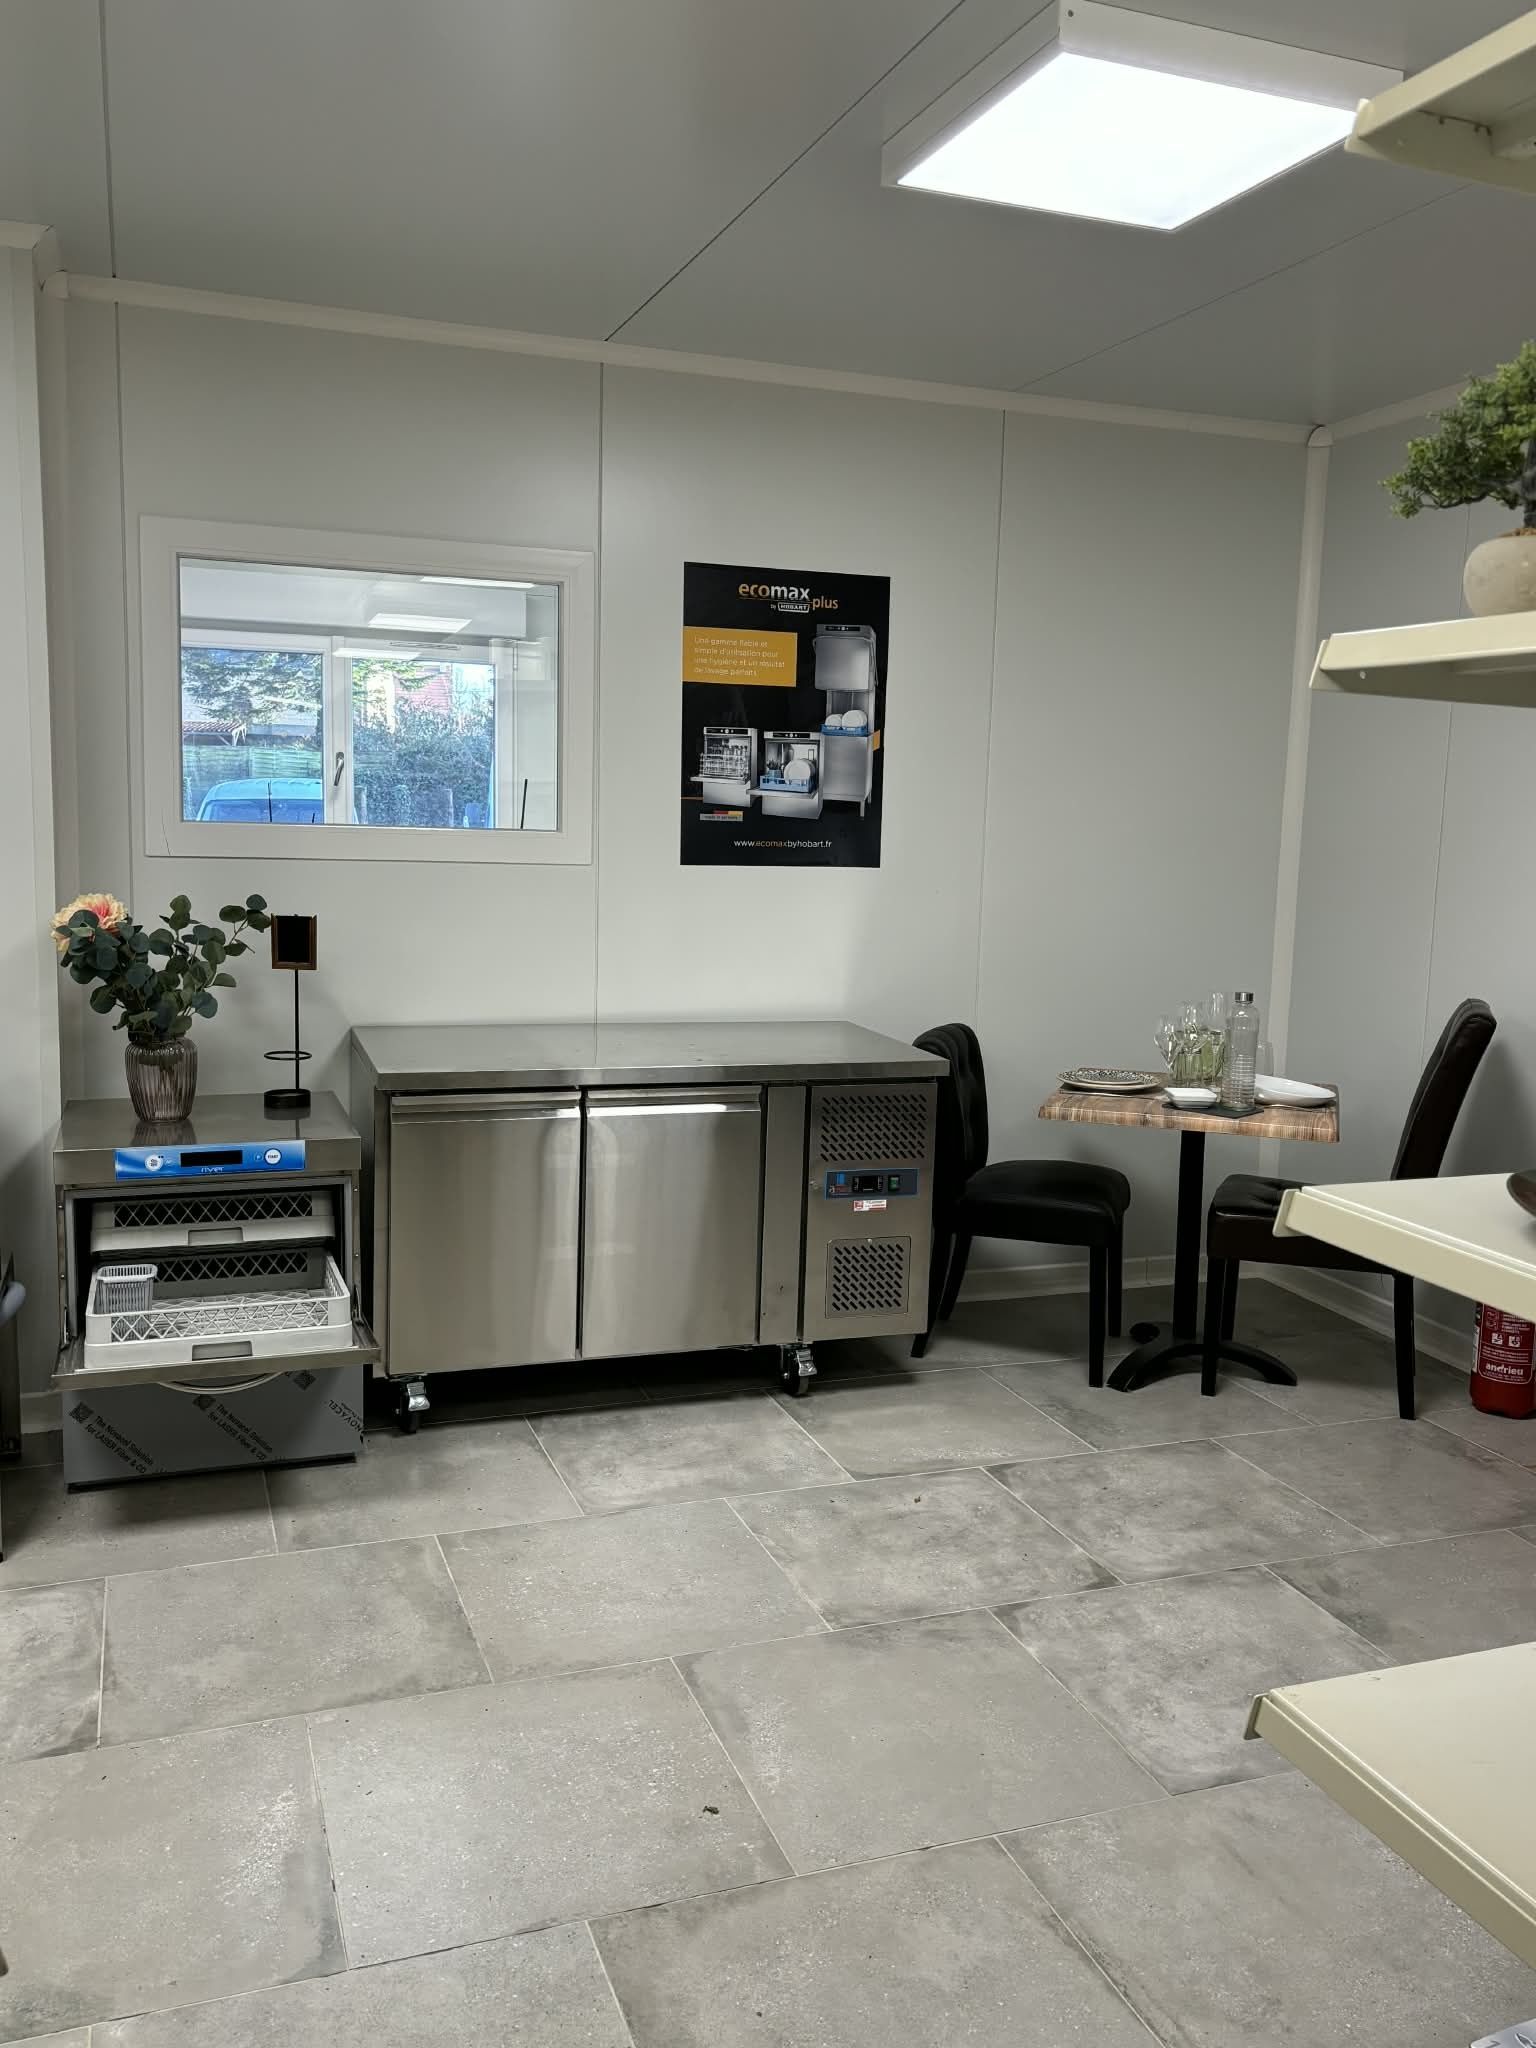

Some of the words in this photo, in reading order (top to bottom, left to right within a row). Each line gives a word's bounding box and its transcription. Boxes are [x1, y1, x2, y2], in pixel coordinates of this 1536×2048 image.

[738, 583, 810, 600] ecomax
[812, 596, 839, 611] plus
[710, 638, 738, 646] gamme
[733, 839, 833, 849] www.ecomaxbyhobart.fr
[1485, 1362, 1524, 1376] andrieu
[94, 1415, 107, 1429] The
[328, 1399, 363, 1433] NOVACEL
[86, 1423, 97, 1435] for
